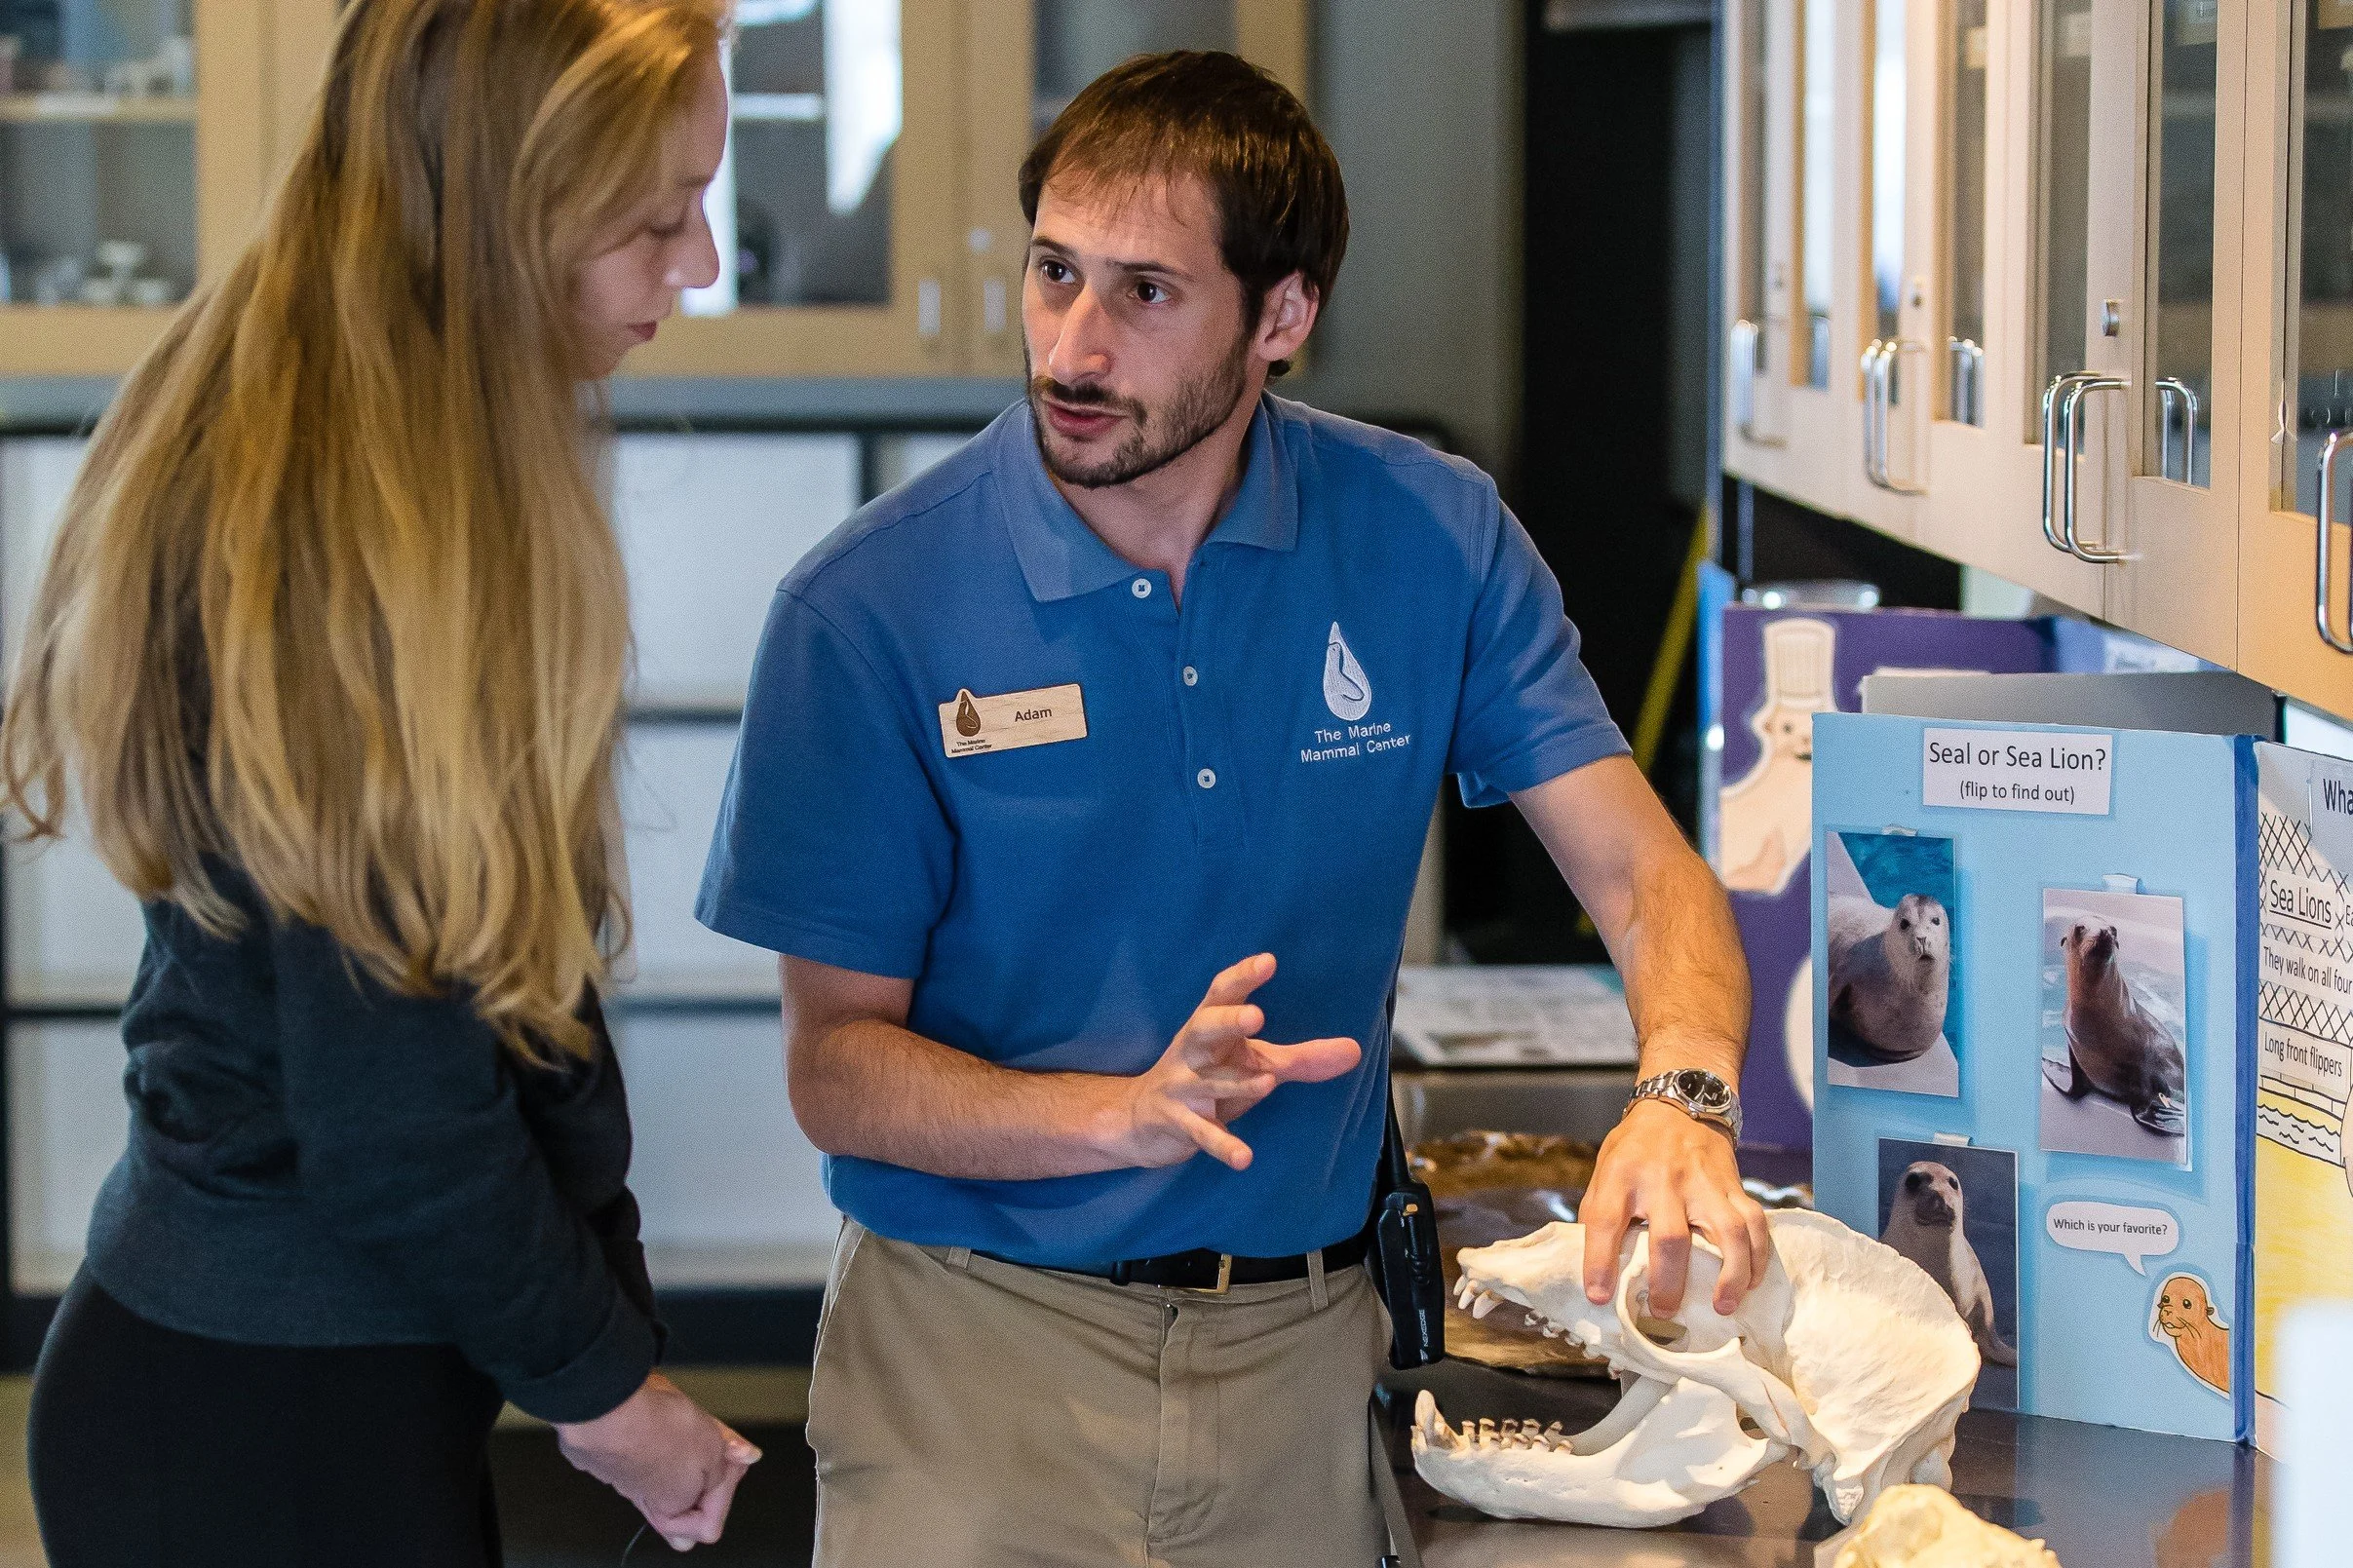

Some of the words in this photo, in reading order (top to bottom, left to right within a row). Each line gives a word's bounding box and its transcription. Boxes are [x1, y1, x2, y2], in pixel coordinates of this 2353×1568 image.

[1014, 708, 1053, 722] Adam
[1313, 729, 1342, 743] The
[1348, 722, 1391, 739] Marine
[1300, 743, 1360, 763] Mammal
[1367, 735, 1410, 753] Center
[1929, 742, 1971, 765] Seal
[1978, 748, 1999, 766] or
[2006, 746, 2042, 768] Sea
[2050, 747, 2106, 771] Lion?
[1960, 780, 1987, 801] (flip
[1992, 784, 2007, 799] to
[2012, 783, 2040, 800] find
[2044, 785, 2074, 805] out)
[2270, 879, 2294, 913] Sea
[2298, 886, 2332, 924] Lions
[2263, 946, 2284, 975] They
[2286, 957, 2306, 979] walk
[2308, 967, 2319, 983] on
[2321, 966, 2332, 988] all
[2334, 969, 2353, 995] four
[2264, 1031, 2285, 1062] Long
[2287, 1038, 2307, 1065] front
[2310, 1048, 2342, 1078] flippers
[2054, 1218, 2085, 1230] Which
[2087, 1220, 2095, 1231] is
[2098, 1223, 2120, 1234] your
[2123, 1222, 2168, 1235] favorite?
